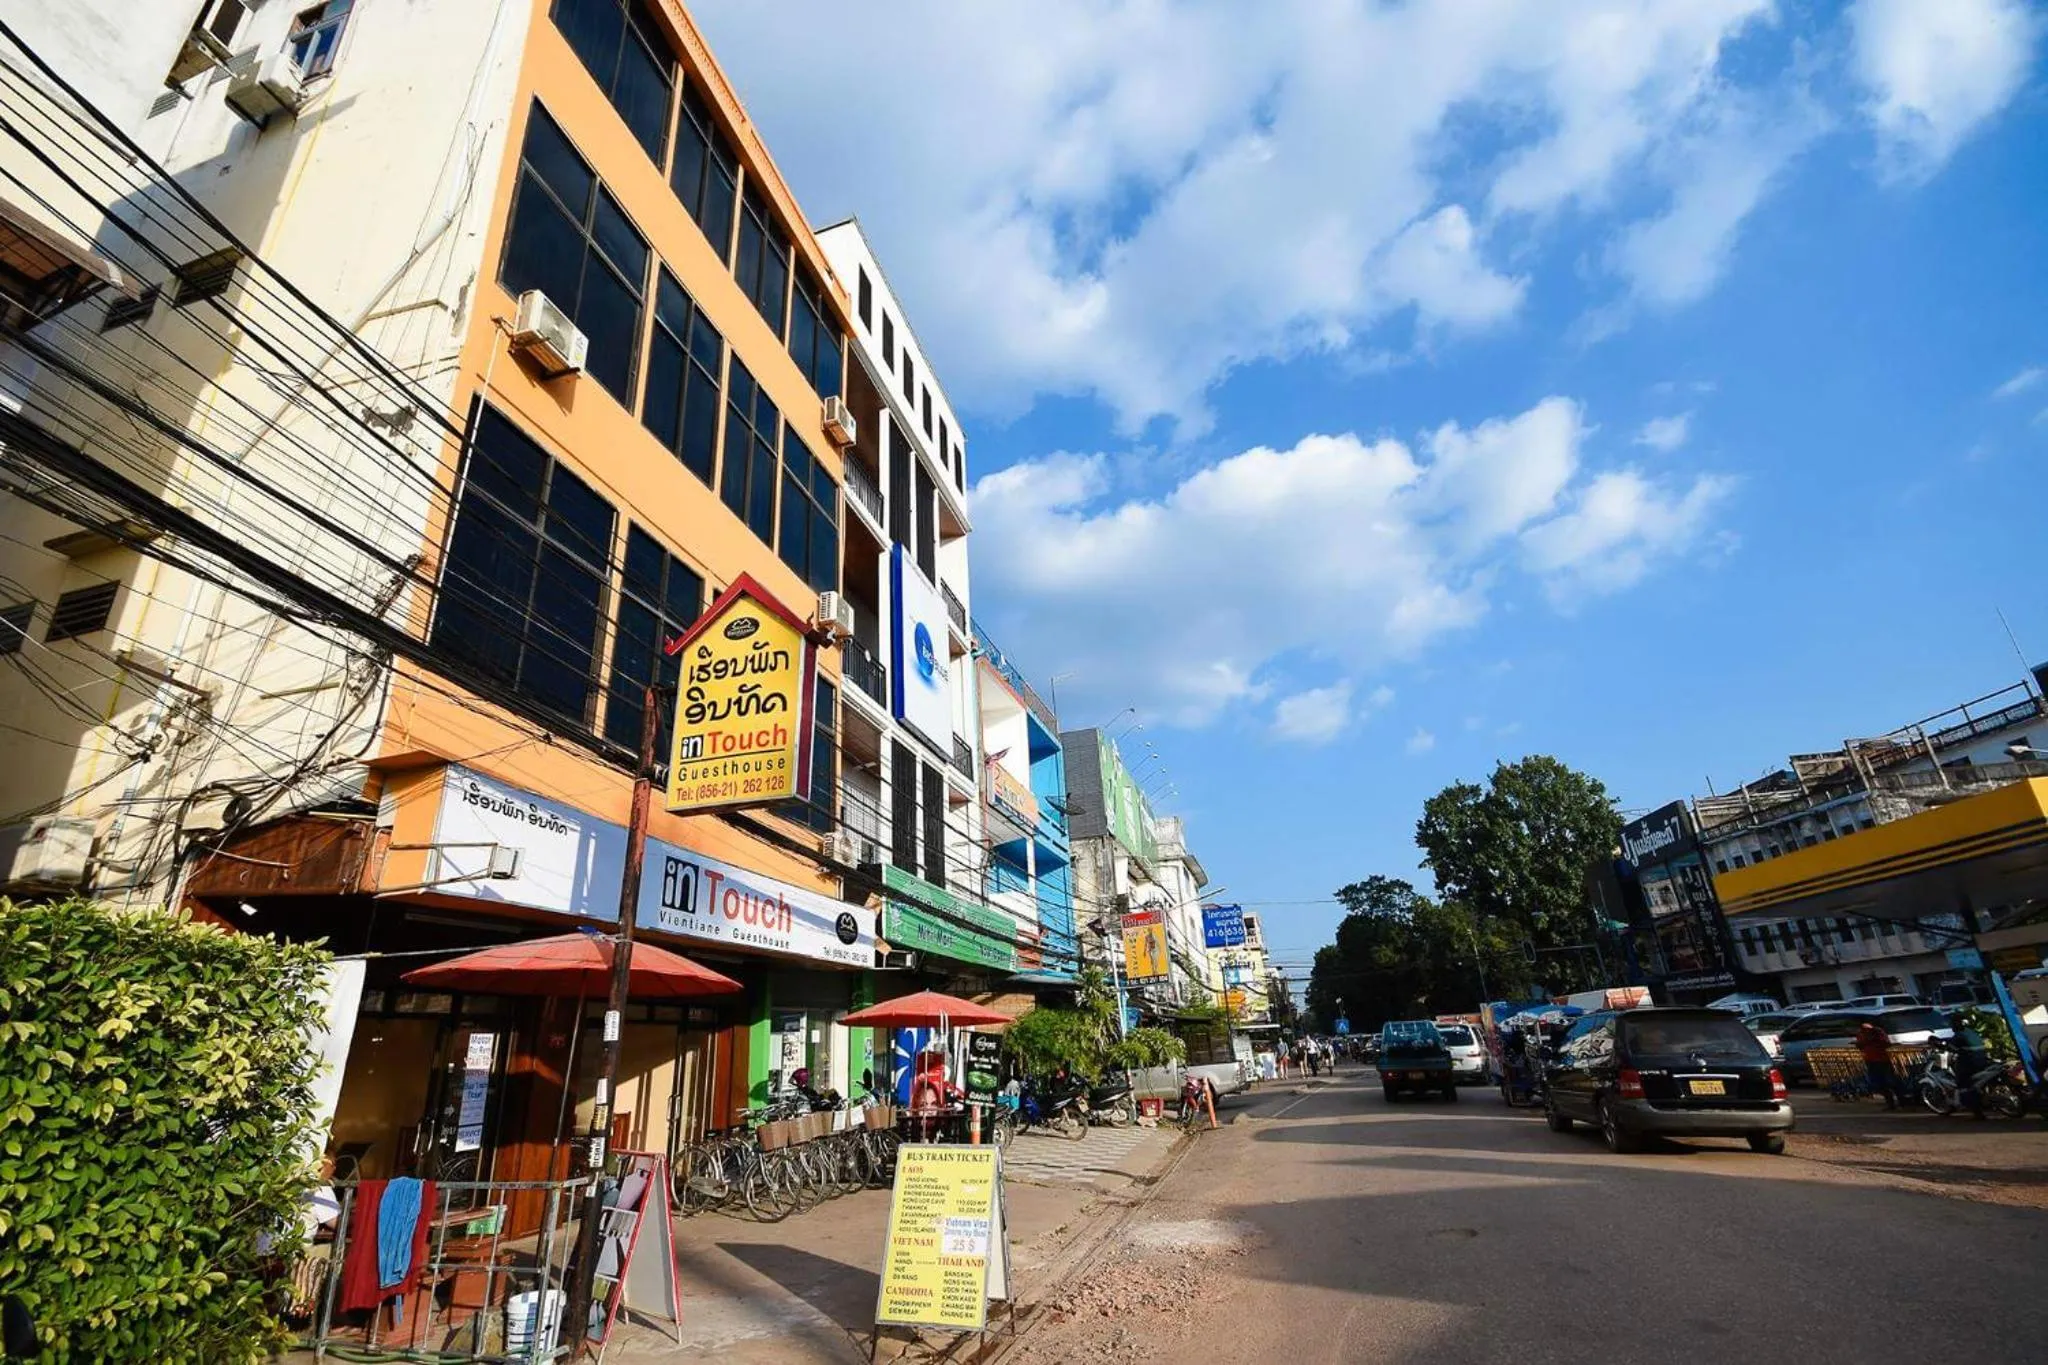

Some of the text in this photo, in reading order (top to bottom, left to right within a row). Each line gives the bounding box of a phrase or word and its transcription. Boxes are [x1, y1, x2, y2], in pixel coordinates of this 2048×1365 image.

[681, 723, 787, 759] in Touch
[678, 758, 785, 781] Guesthouse
[696, 781, 738, 802] (856-21)
[743, 777, 762, 793] 262
[663, 858, 793, 934] in Touch
[659, 911, 791, 950] Vientiane Guesthouse
[907, 1152, 991, 1162] BUS TRAIN TICKET
[902, 1166, 924, 1174] LAOS
[937, 1257, 985, 1268] THAILAND
[885, 1285, 933, 1297] CAMBODIA
